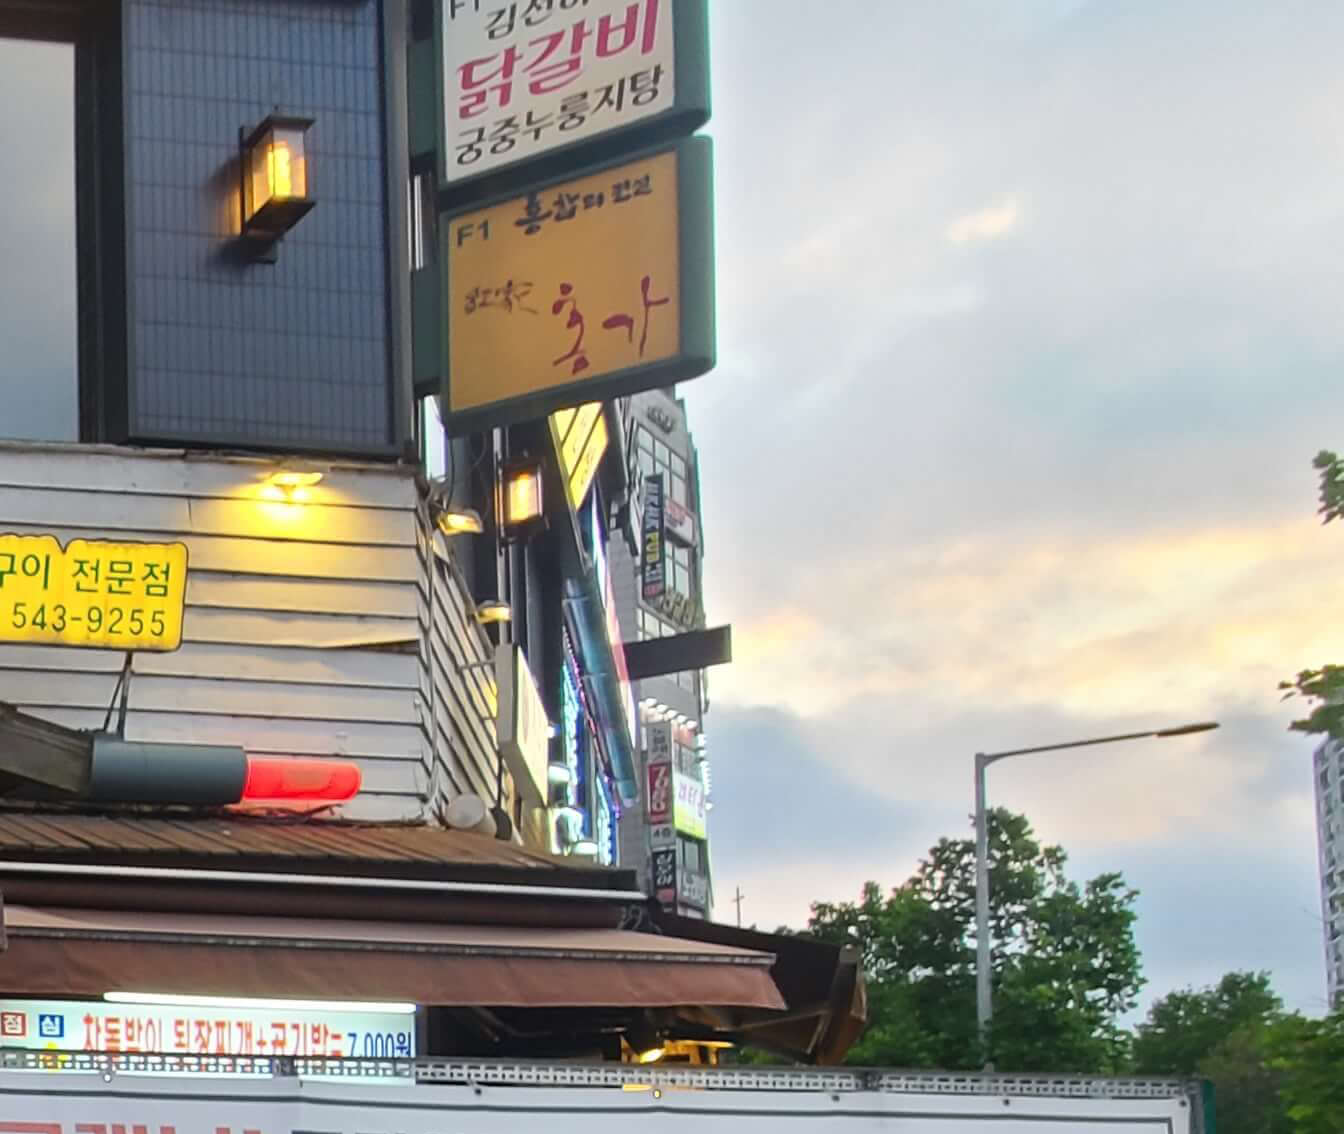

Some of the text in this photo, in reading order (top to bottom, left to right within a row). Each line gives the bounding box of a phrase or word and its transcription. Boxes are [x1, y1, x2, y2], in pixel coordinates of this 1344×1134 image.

[485, 0, 589, 40] 김선
[457, 0, 660, 120] 닭갈비
[456, 219, 490, 246] F1
[70, 558, 172, 598] 전문점
[11, 602, 167, 638] 543-9255
